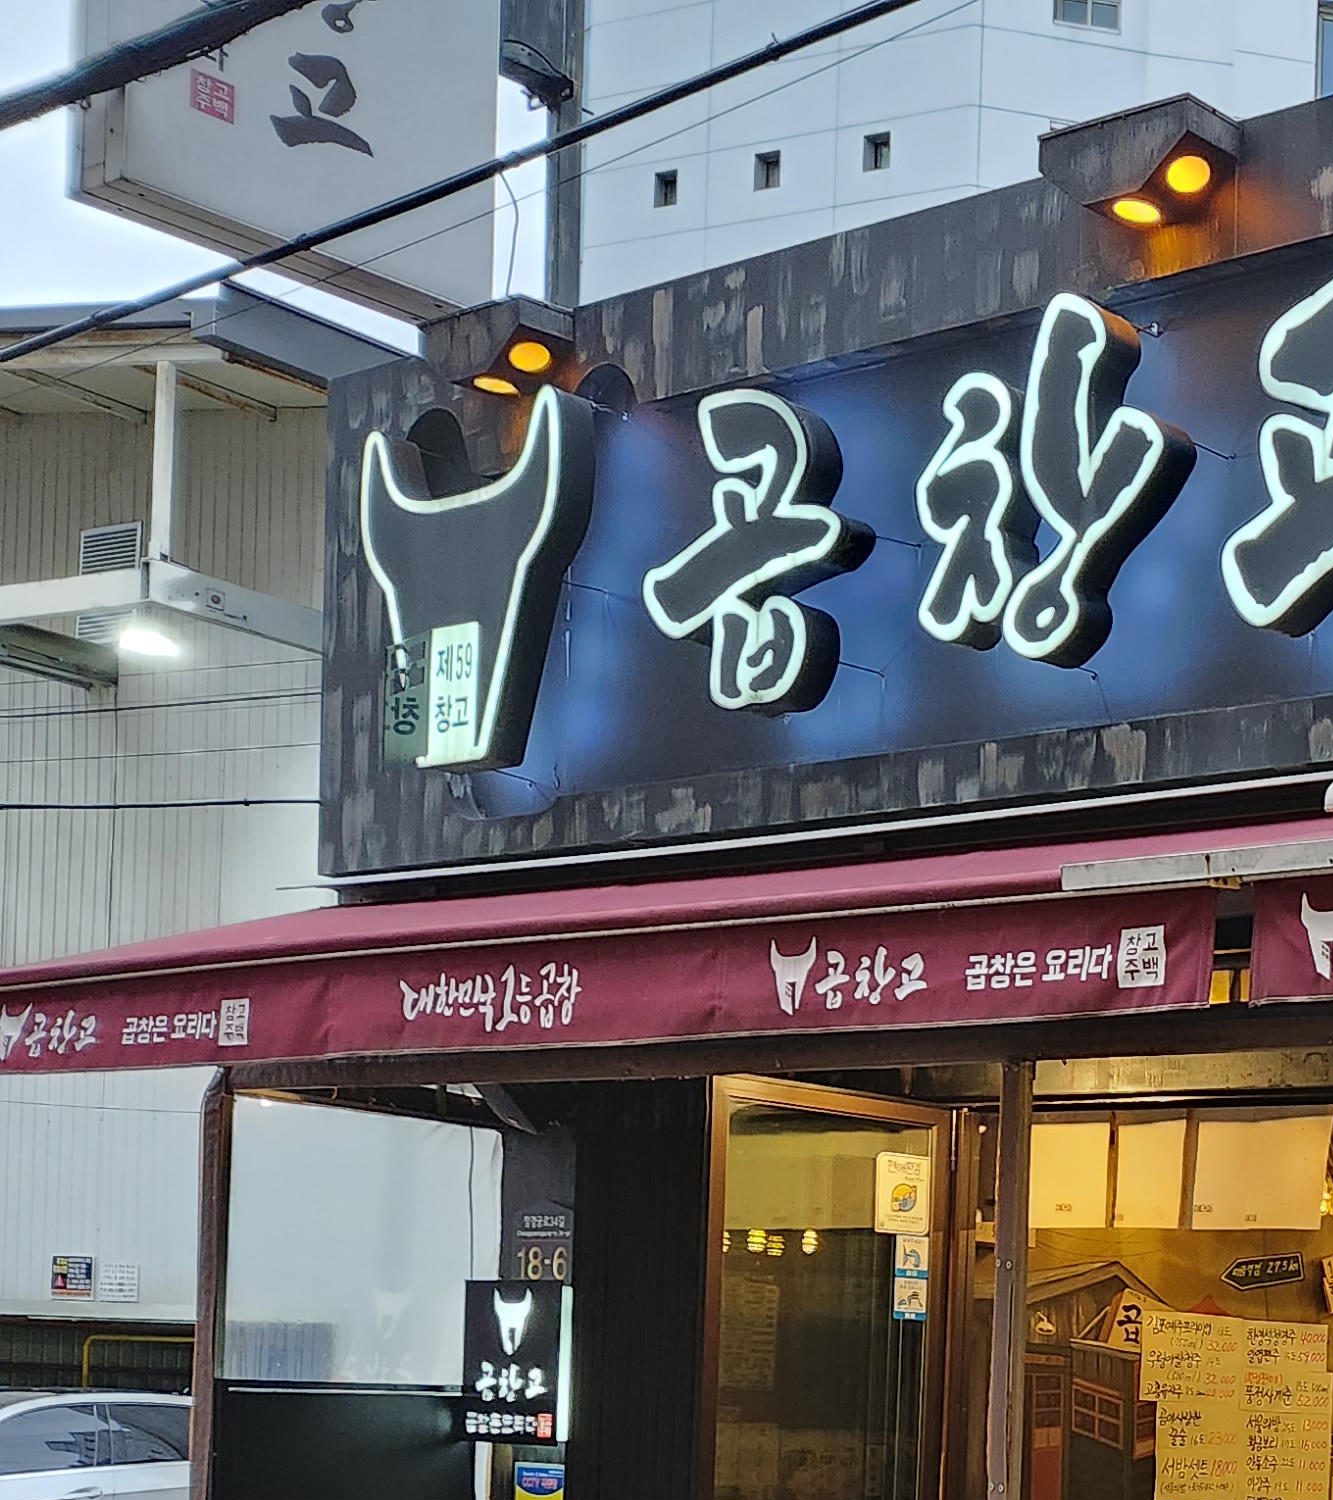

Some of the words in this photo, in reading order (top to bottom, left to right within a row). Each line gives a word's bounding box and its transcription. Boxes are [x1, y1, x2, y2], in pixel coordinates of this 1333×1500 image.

[435, 694, 469, 733] 창고
[1126, 933, 1160, 956] 창고
[815, 945, 928, 1010] 곱창고
[965, 951, 1036, 991] 곱창은
[1041, 944, 1113, 982] 요리다
[1124, 956, 1160, 981] 주백
[25, 1010, 97, 1058] 곱창고
[121, 1015, 169, 1045] 곱창은
[171, 1011, 218, 1040] 요리다
[517, 1246, 568, 1280] 18-6
